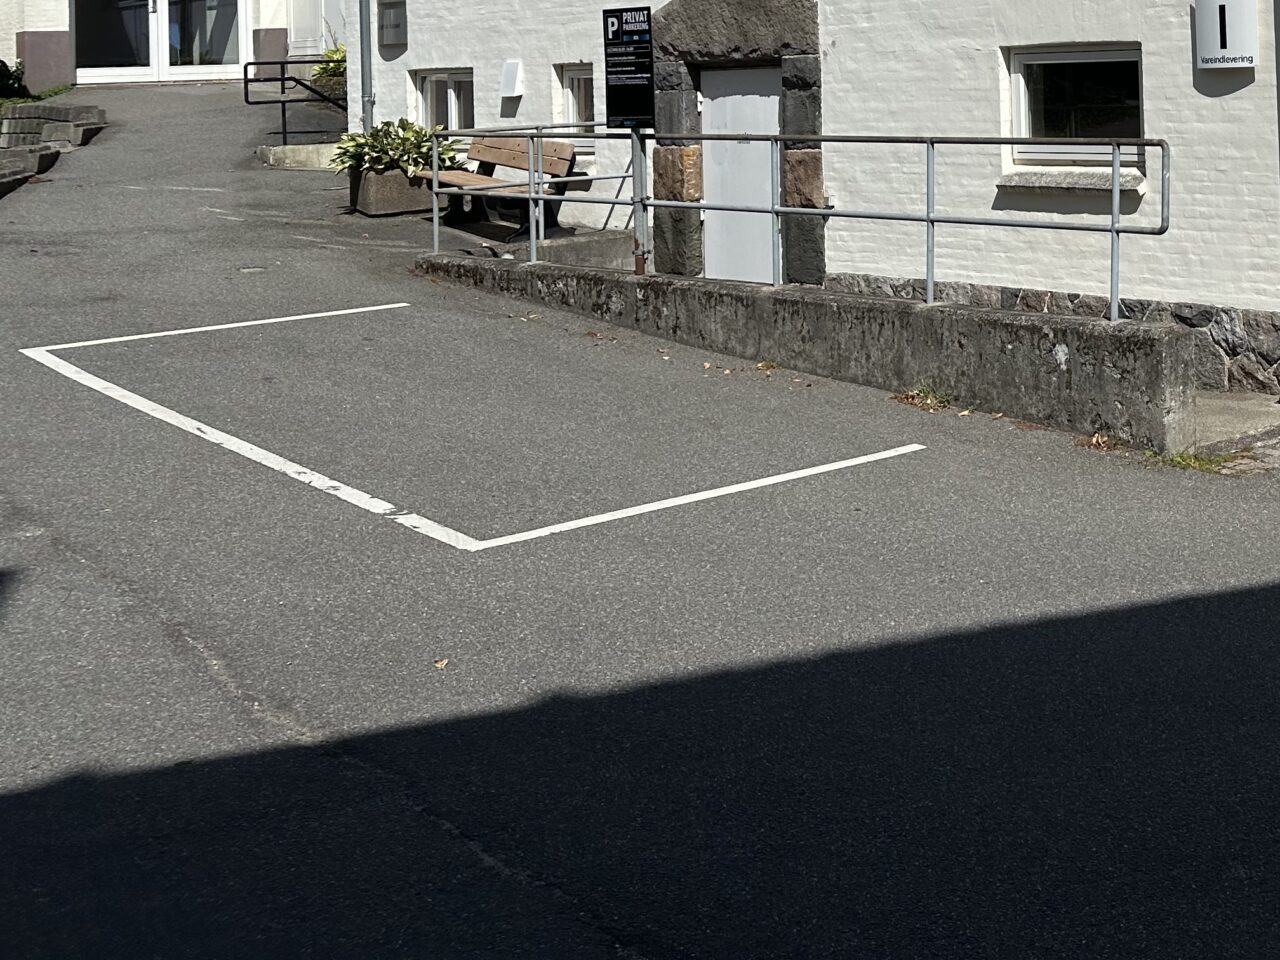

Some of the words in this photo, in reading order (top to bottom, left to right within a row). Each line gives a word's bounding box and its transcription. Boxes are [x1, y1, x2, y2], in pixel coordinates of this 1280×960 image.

[622, 10, 648, 23] PRIVAT
[607, 17, 619, 39] P
[1200, 54, 1254, 64] Vareindlevering
